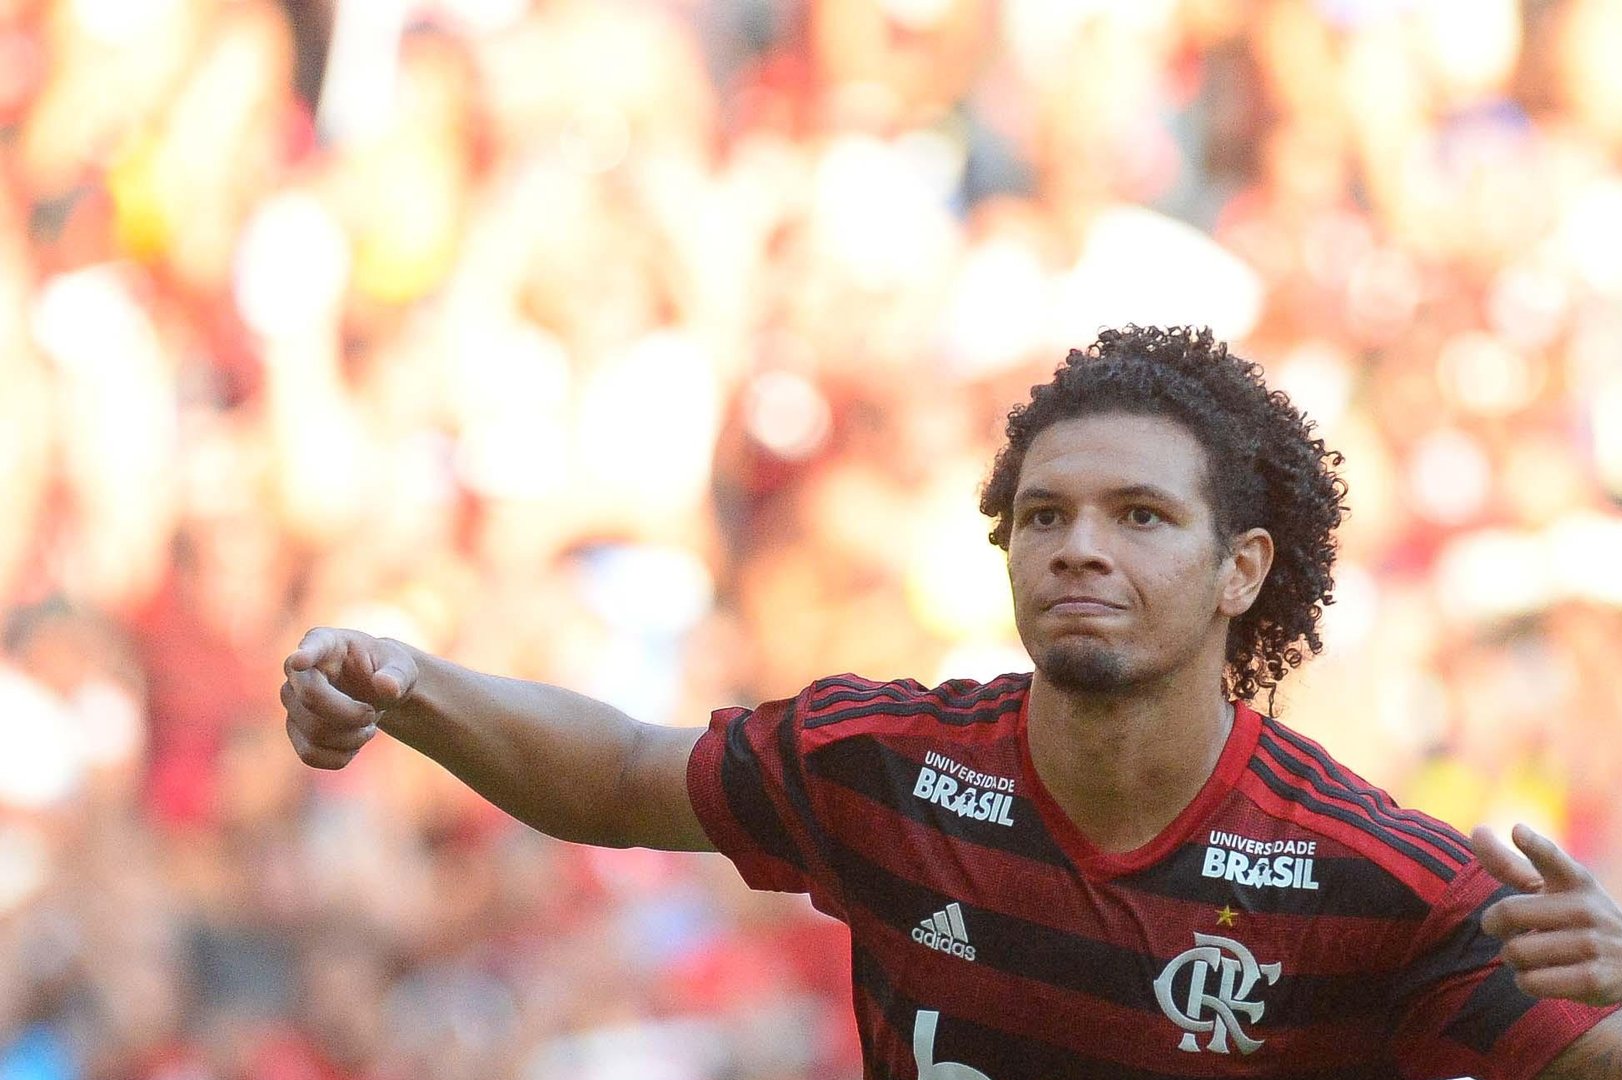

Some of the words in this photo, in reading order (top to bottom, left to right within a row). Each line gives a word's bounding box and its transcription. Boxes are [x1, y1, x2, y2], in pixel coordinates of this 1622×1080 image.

[924, 750, 1016, 793] UNIVERSIDADE
[912, 766, 1015, 828] BRASIL
[1209, 830, 1317, 856] UNIVERSDADE
[1201, 846, 1320, 890] BRASIL
[911, 927, 976, 961] adidas
